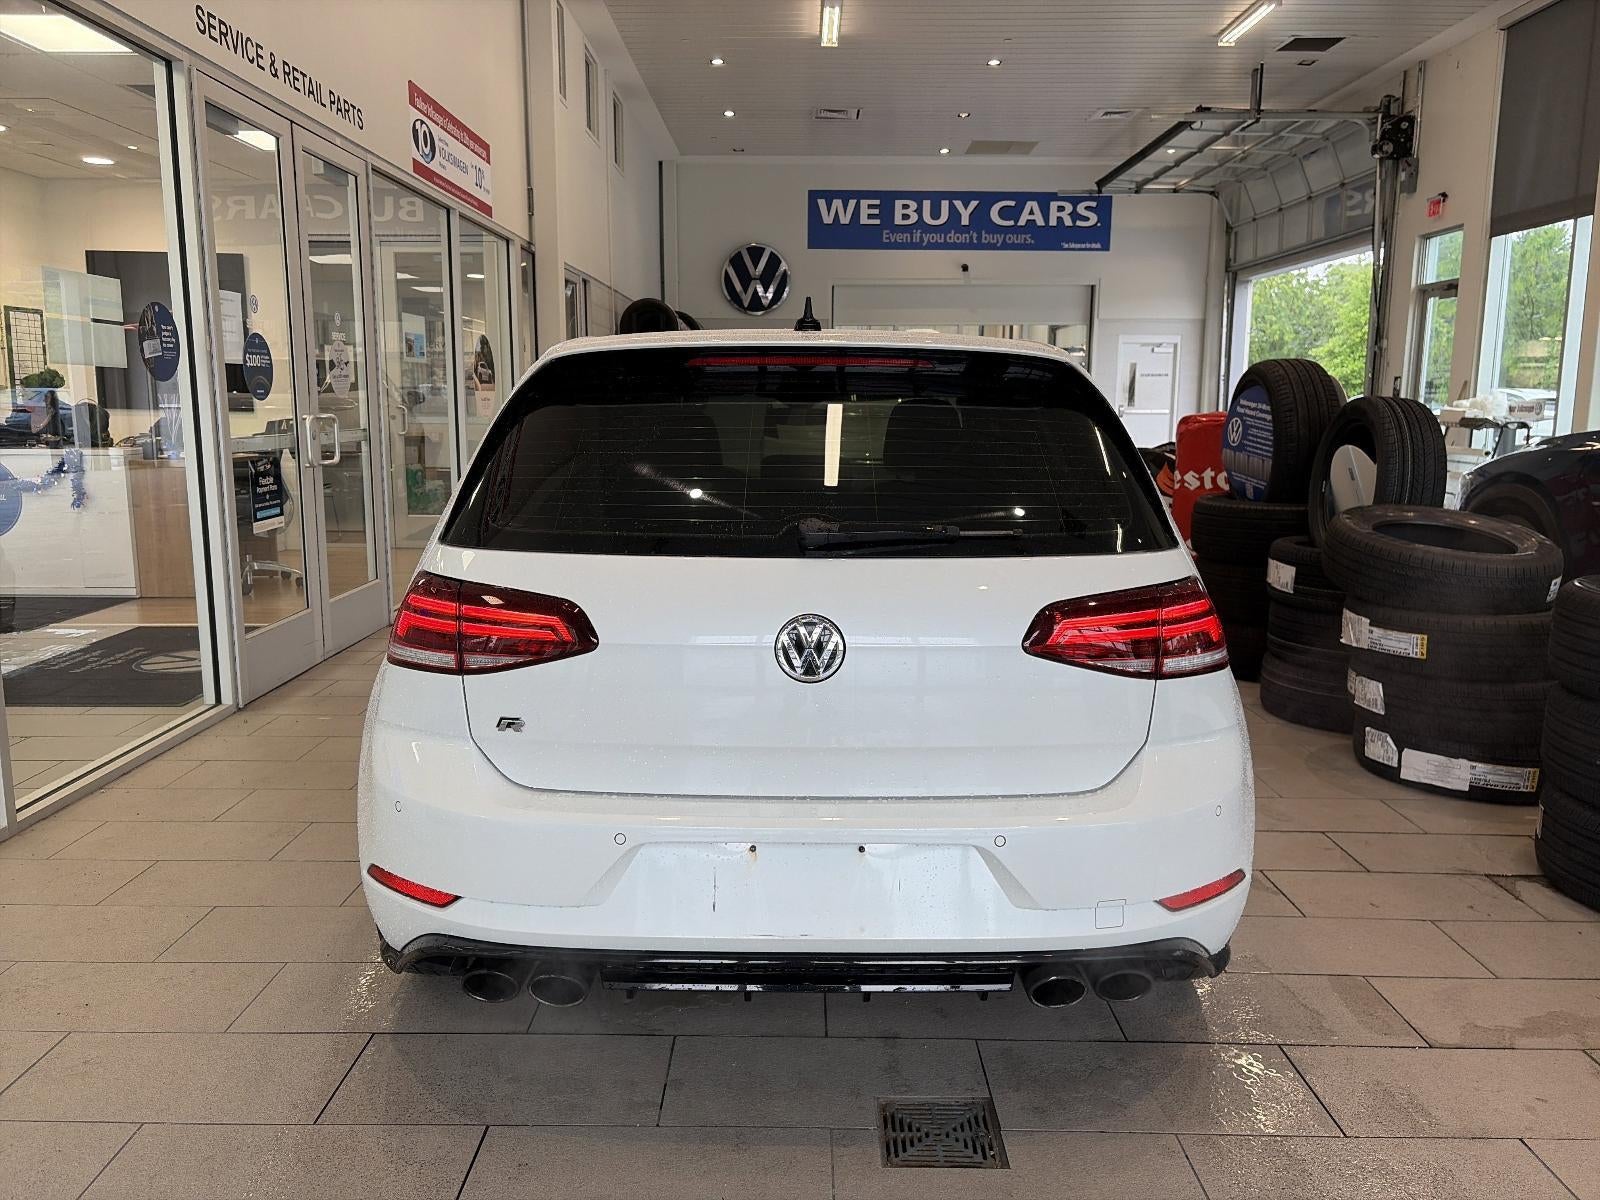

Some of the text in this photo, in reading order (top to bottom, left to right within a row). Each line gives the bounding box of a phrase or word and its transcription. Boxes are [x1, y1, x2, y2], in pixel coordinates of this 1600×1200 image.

[195, 4, 364, 131] SERVICE & RETAIL PARTS
[816, 198, 1102, 228] WE BUY CARS.
[882, 229, 1035, 247] Even if you don't buy ours.
[246, 353, 261, 368] $100
